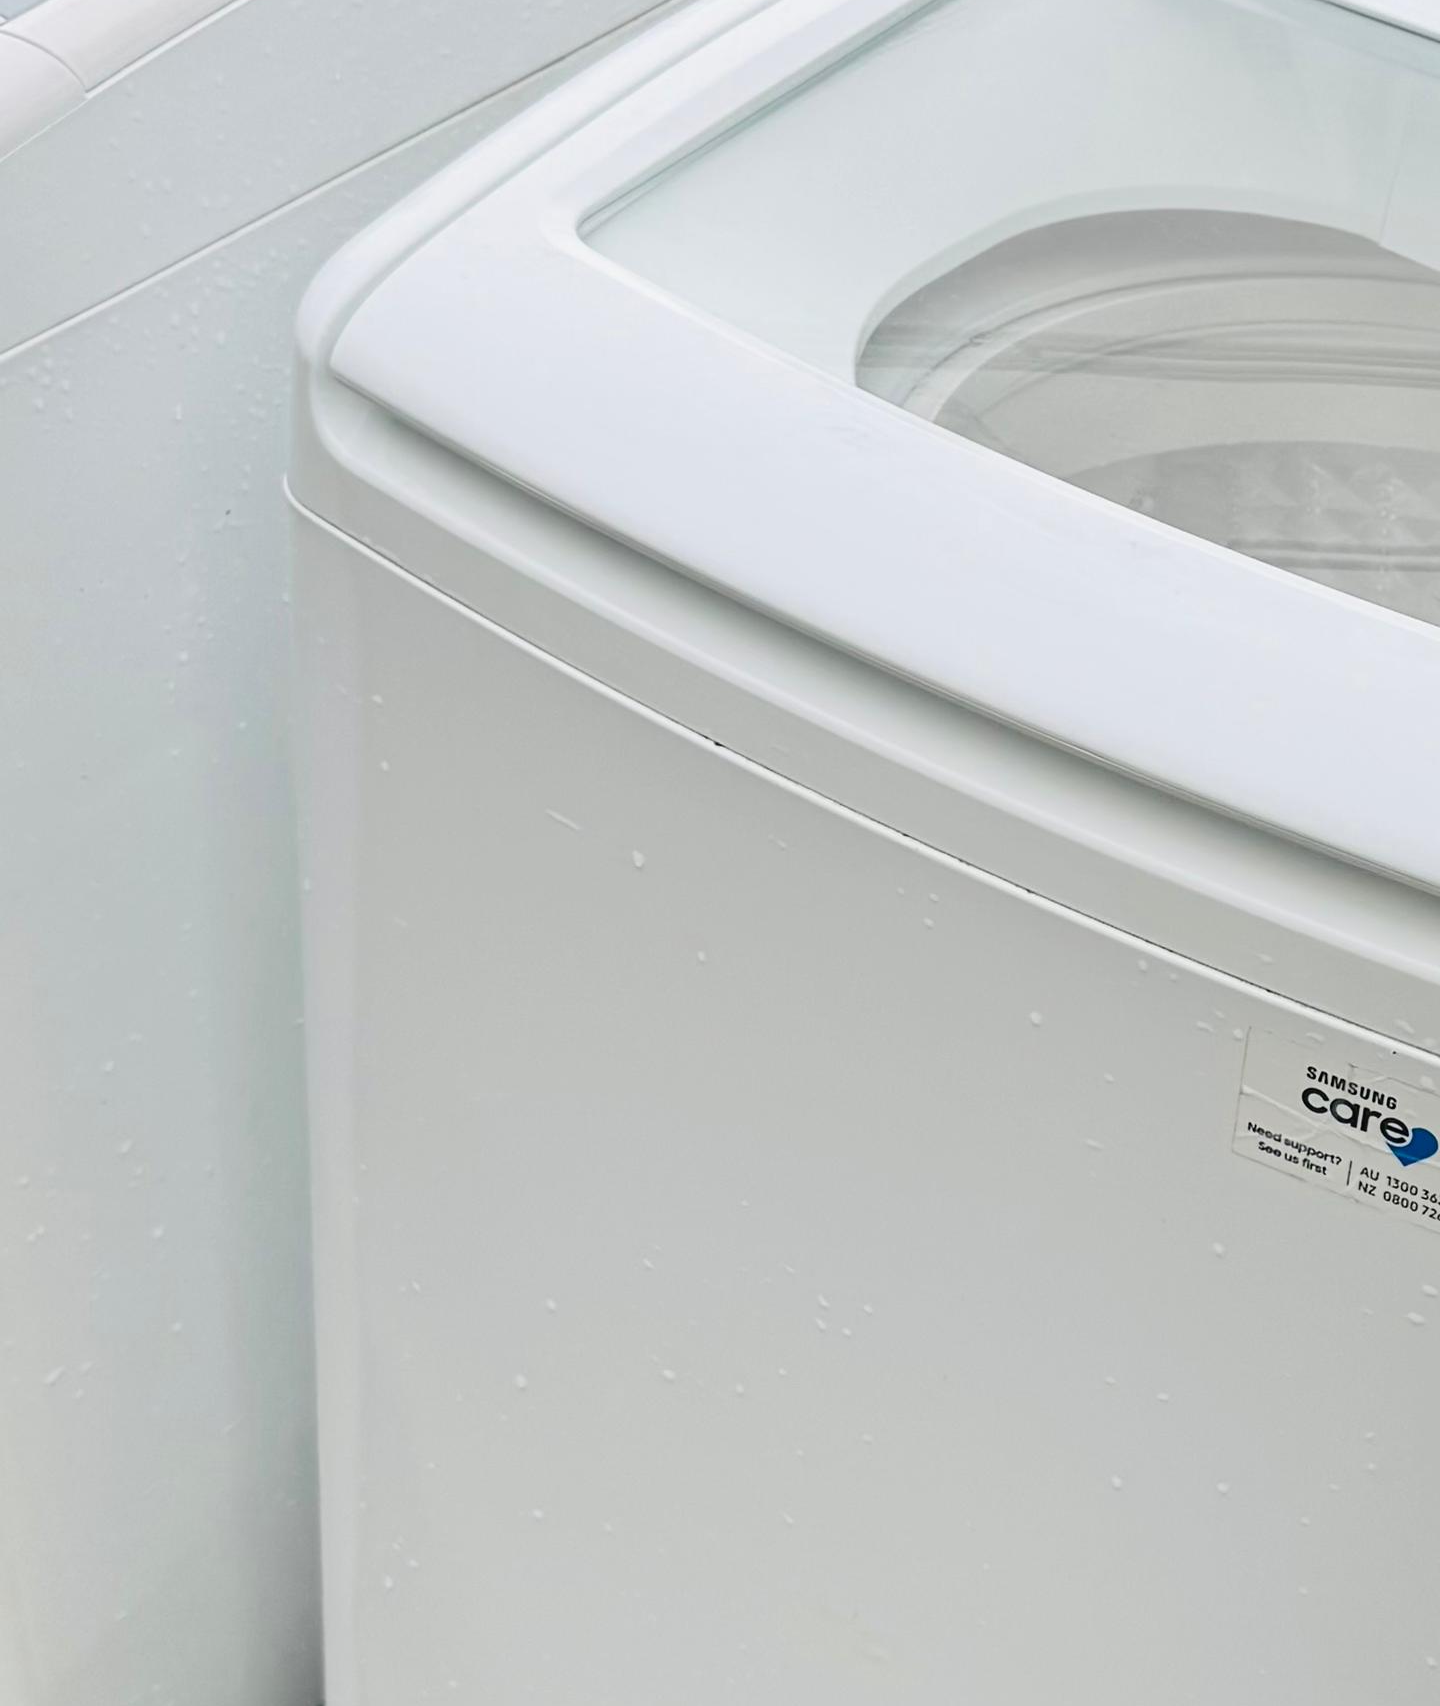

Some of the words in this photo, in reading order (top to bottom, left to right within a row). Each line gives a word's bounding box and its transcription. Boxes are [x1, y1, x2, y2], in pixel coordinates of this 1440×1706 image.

[1306, 1066, 1398, 1110] SAMSUNG
[1301, 1087, 1410, 1144] care
[1247, 1121, 1282, 1143] Need
[1284, 1137, 1342, 1166] support?
[1258, 1141, 1281, 1158] See
[1284, 1153, 1299, 1165] us
[1301, 1159, 1327, 1176] first
[1358, 1180, 1377, 1197] NZ
[1383, 1191, 1418, 1212] 0800
[1360, 1166, 1380, 1181] AU
[1386, 1175, 1419, 1196] 1300
